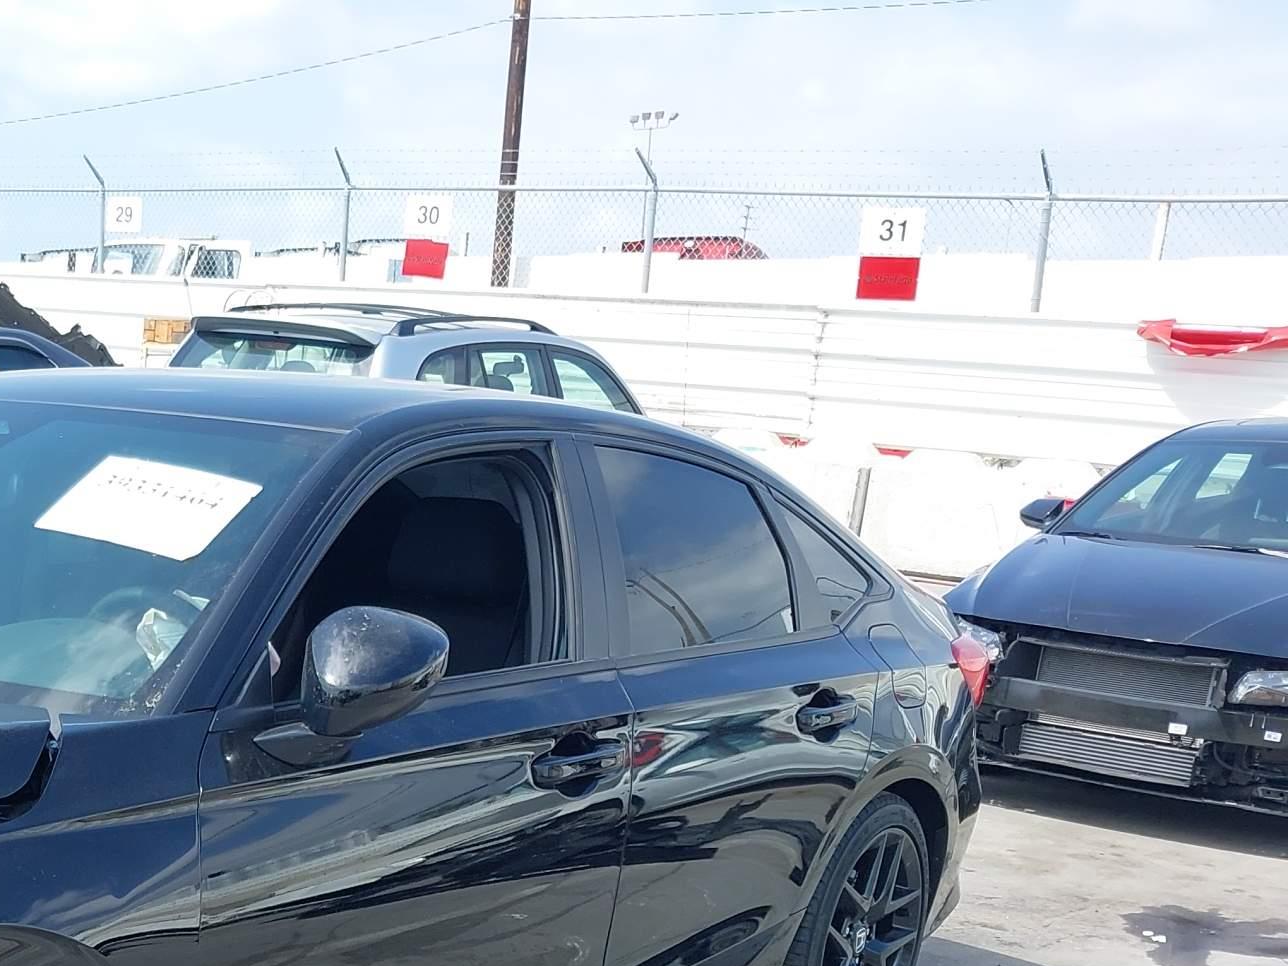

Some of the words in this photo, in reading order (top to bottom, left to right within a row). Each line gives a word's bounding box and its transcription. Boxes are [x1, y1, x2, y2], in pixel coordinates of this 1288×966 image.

[116, 206, 133, 223] 29
[417, 205, 440, 224] 30
[879, 219, 908, 242] 31
